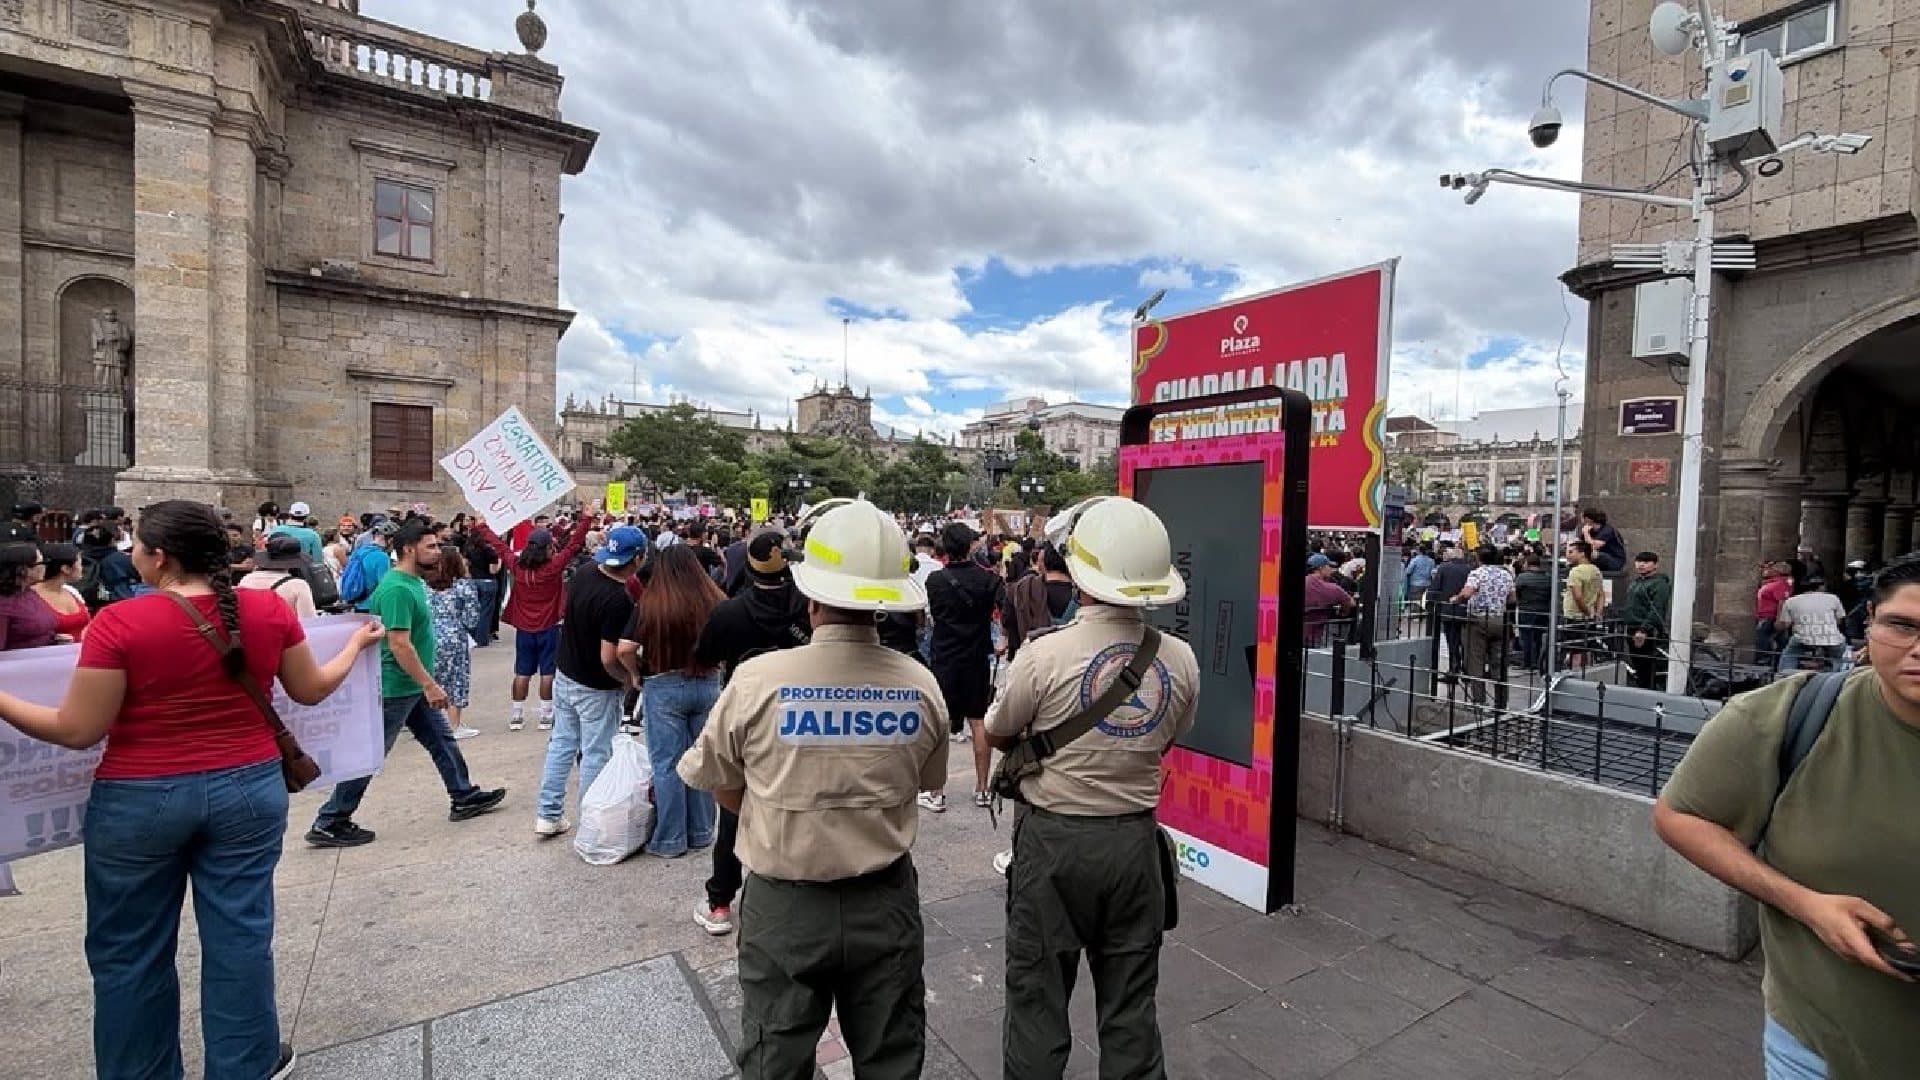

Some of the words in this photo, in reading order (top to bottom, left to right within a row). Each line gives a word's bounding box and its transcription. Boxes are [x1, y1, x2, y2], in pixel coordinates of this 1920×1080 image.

[1221, 336, 1260, 353] Plaza
[780, 685, 883, 701] PROTECCIÓN
[885, 688, 921, 701] CIVIL
[780, 710, 920, 736] JALISCO
